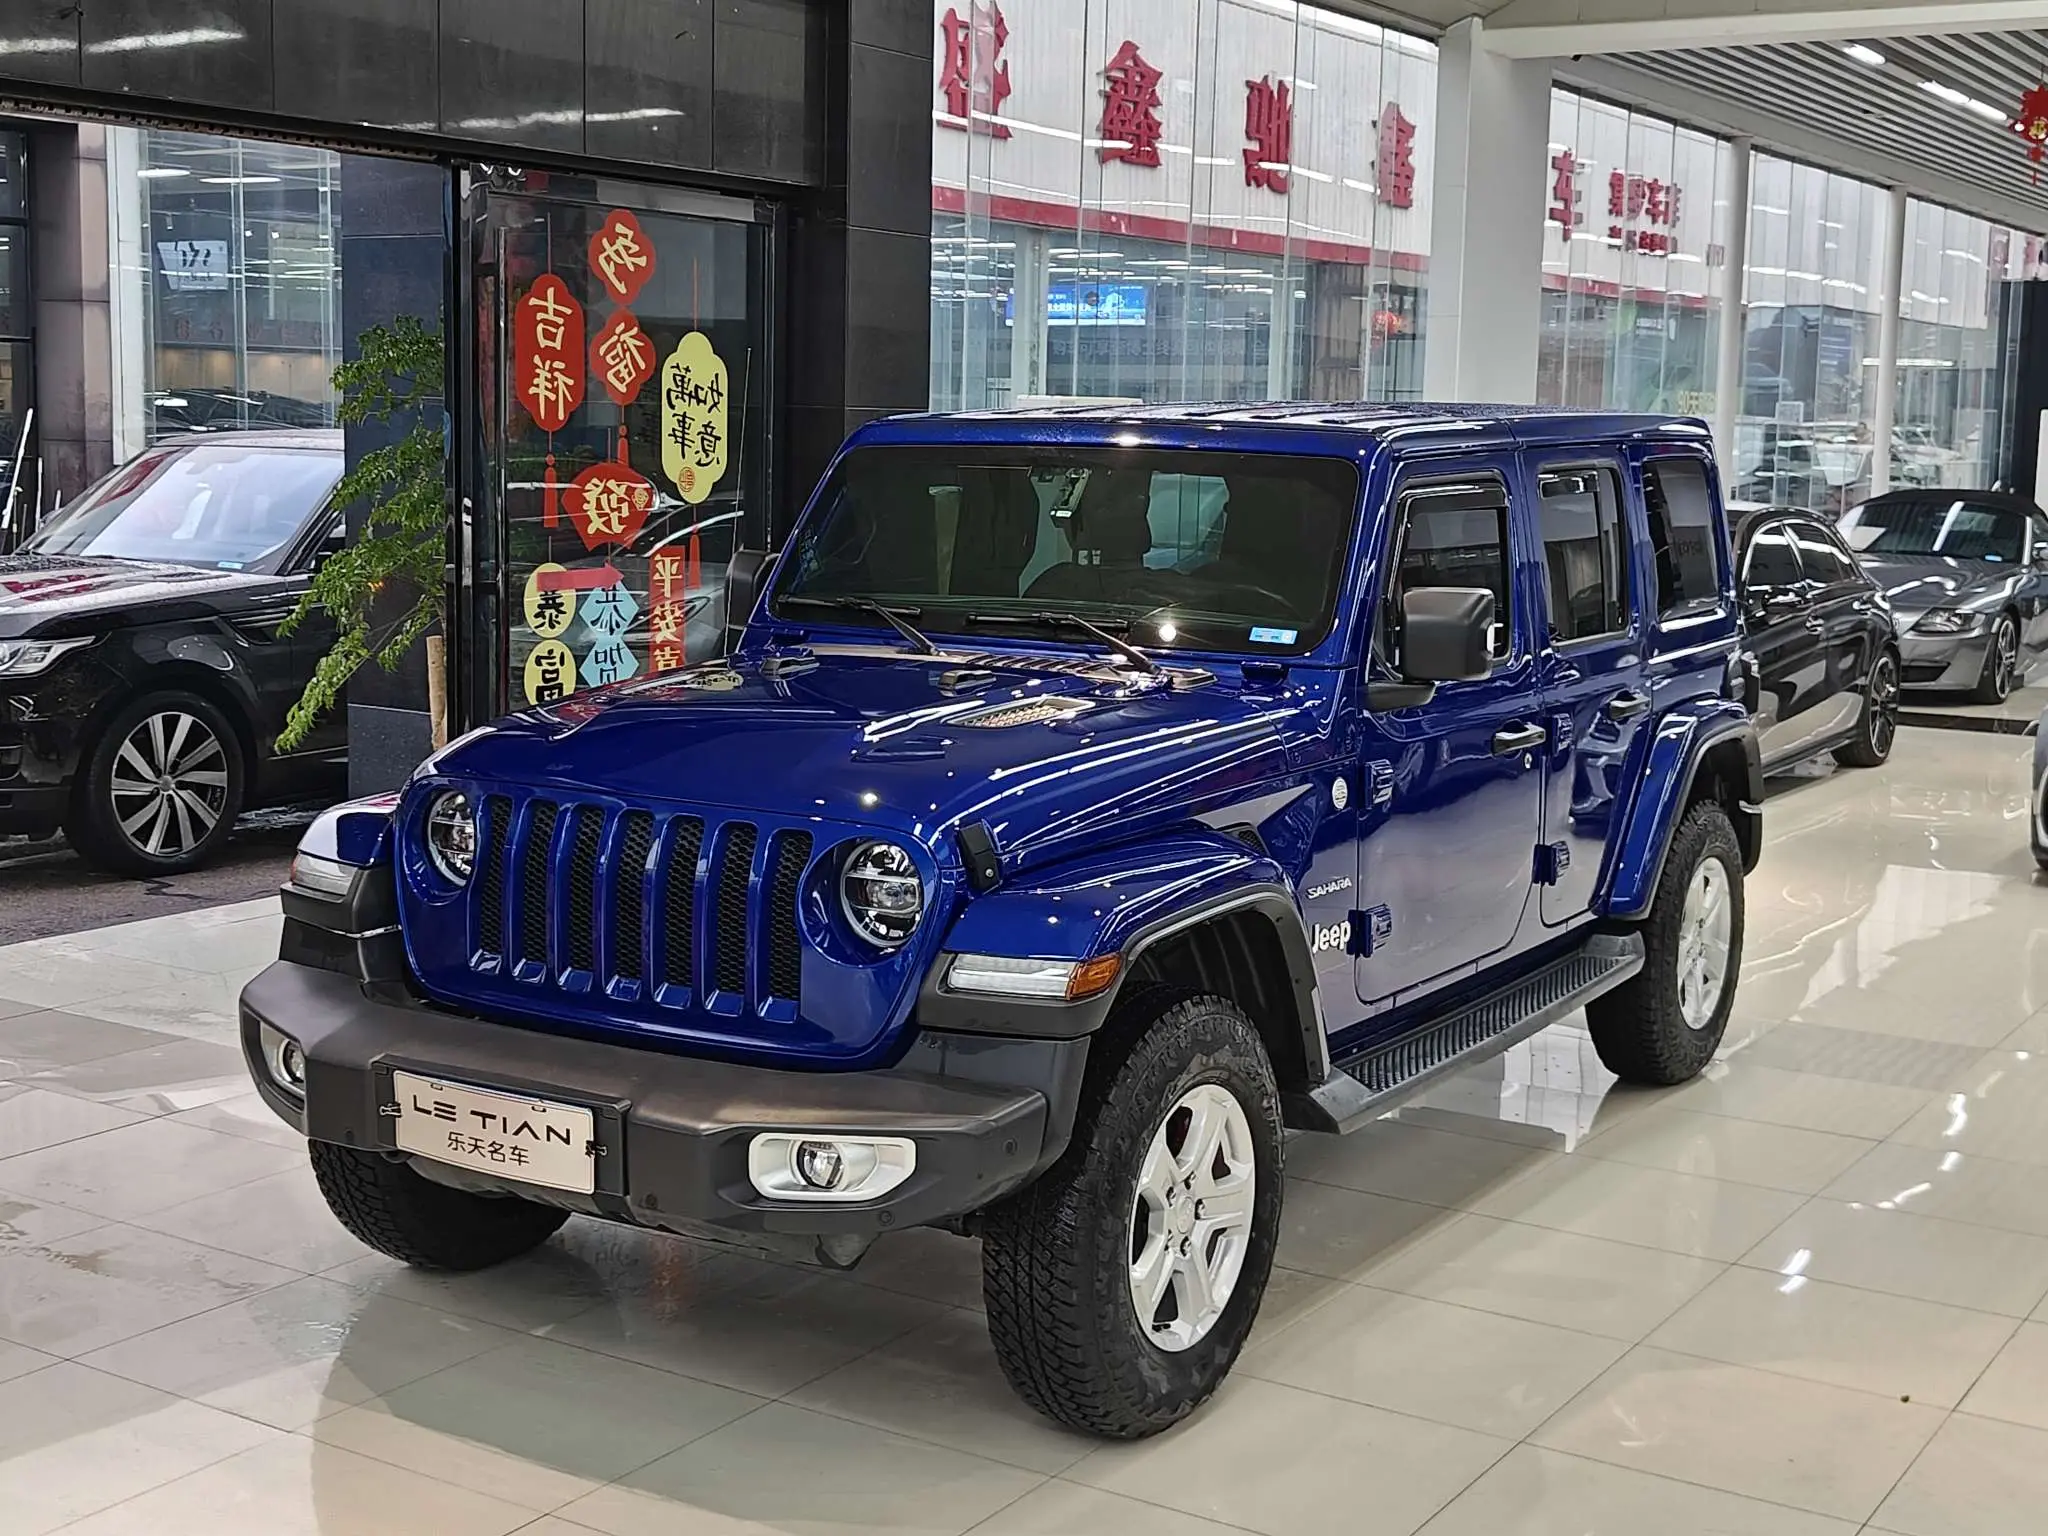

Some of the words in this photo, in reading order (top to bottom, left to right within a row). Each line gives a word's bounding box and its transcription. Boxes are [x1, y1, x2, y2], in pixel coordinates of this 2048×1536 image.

[1307, 877, 1353, 899] SAHARA
[1312, 920, 1351, 953] Jeep
[412, 1094, 457, 1122] LE
[470, 1110, 571, 1146] TIAN
[447, 1131, 530, 1167] 乐天名车
